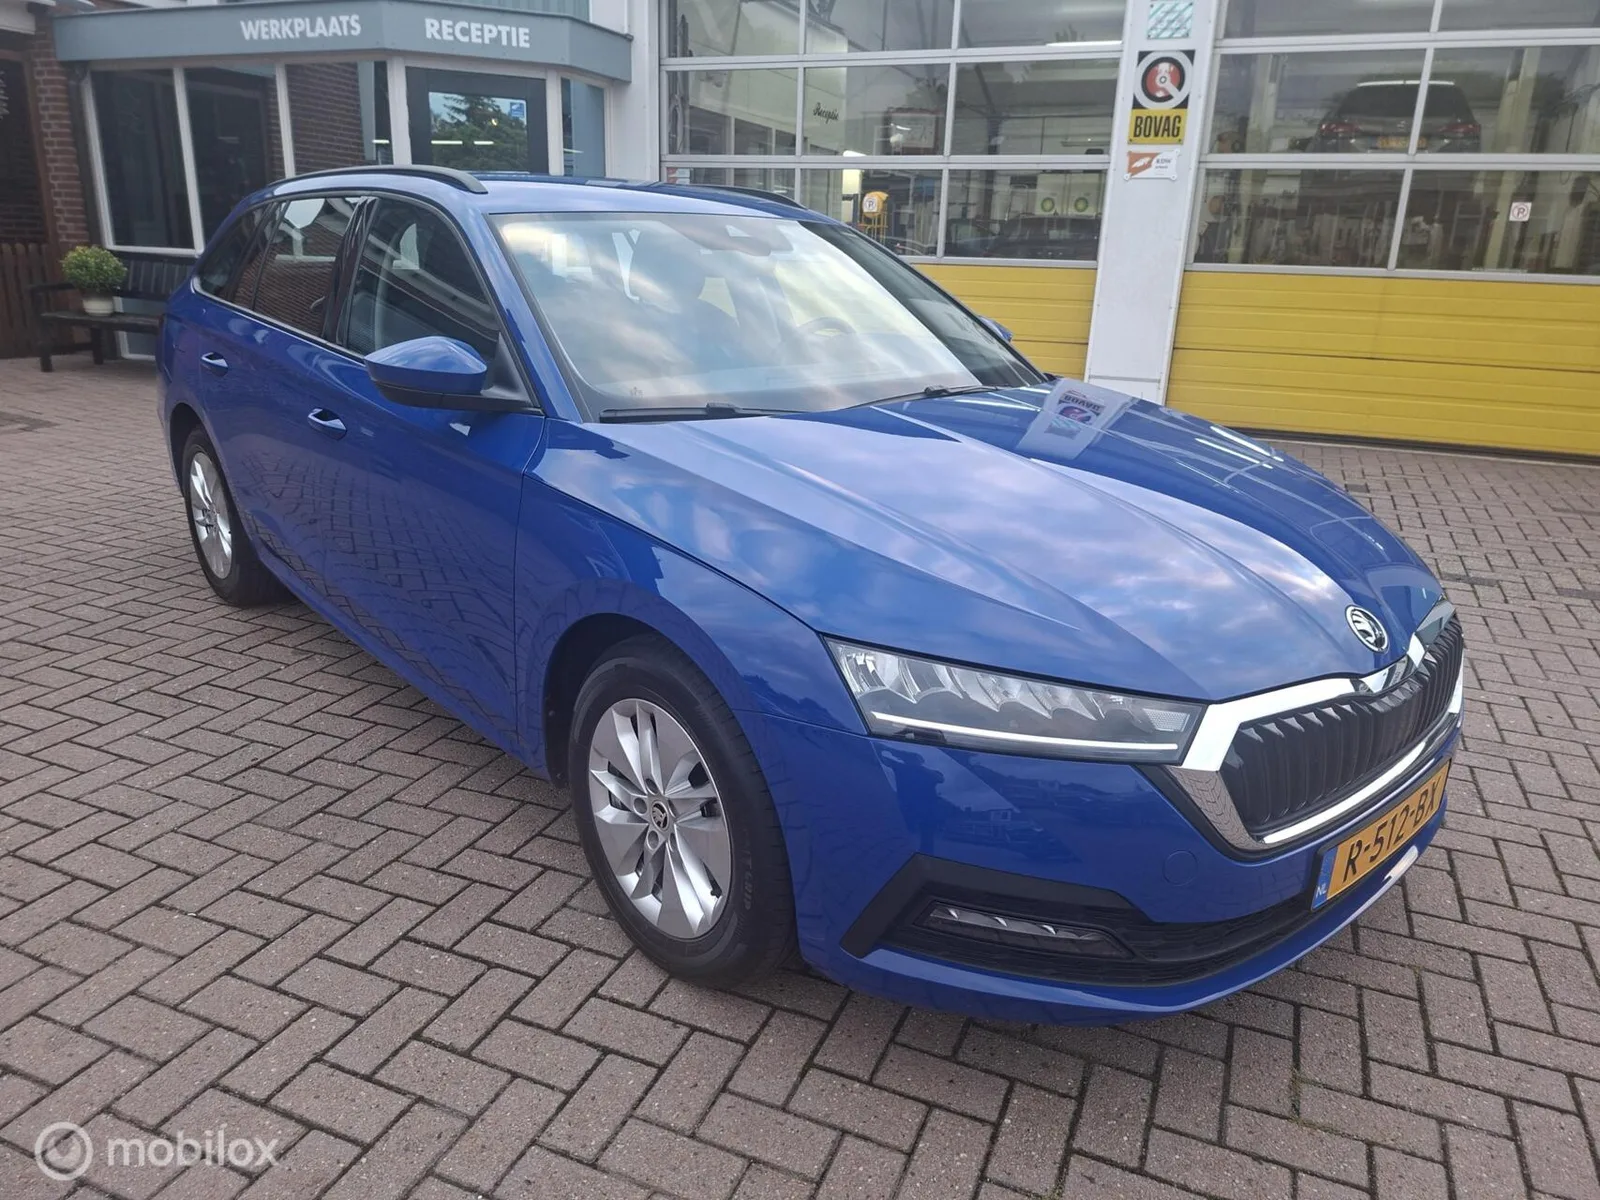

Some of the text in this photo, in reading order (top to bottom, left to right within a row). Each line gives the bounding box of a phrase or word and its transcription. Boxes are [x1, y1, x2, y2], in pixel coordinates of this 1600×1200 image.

[240, 14, 361, 40] WERKPLAATS
[424, 17, 530, 48] RECEPTIE
[1133, 115, 1182, 138] BOVAG
[1343, 775, 1442, 882] R-512-BX
[1316, 883, 1328, 898] NL
